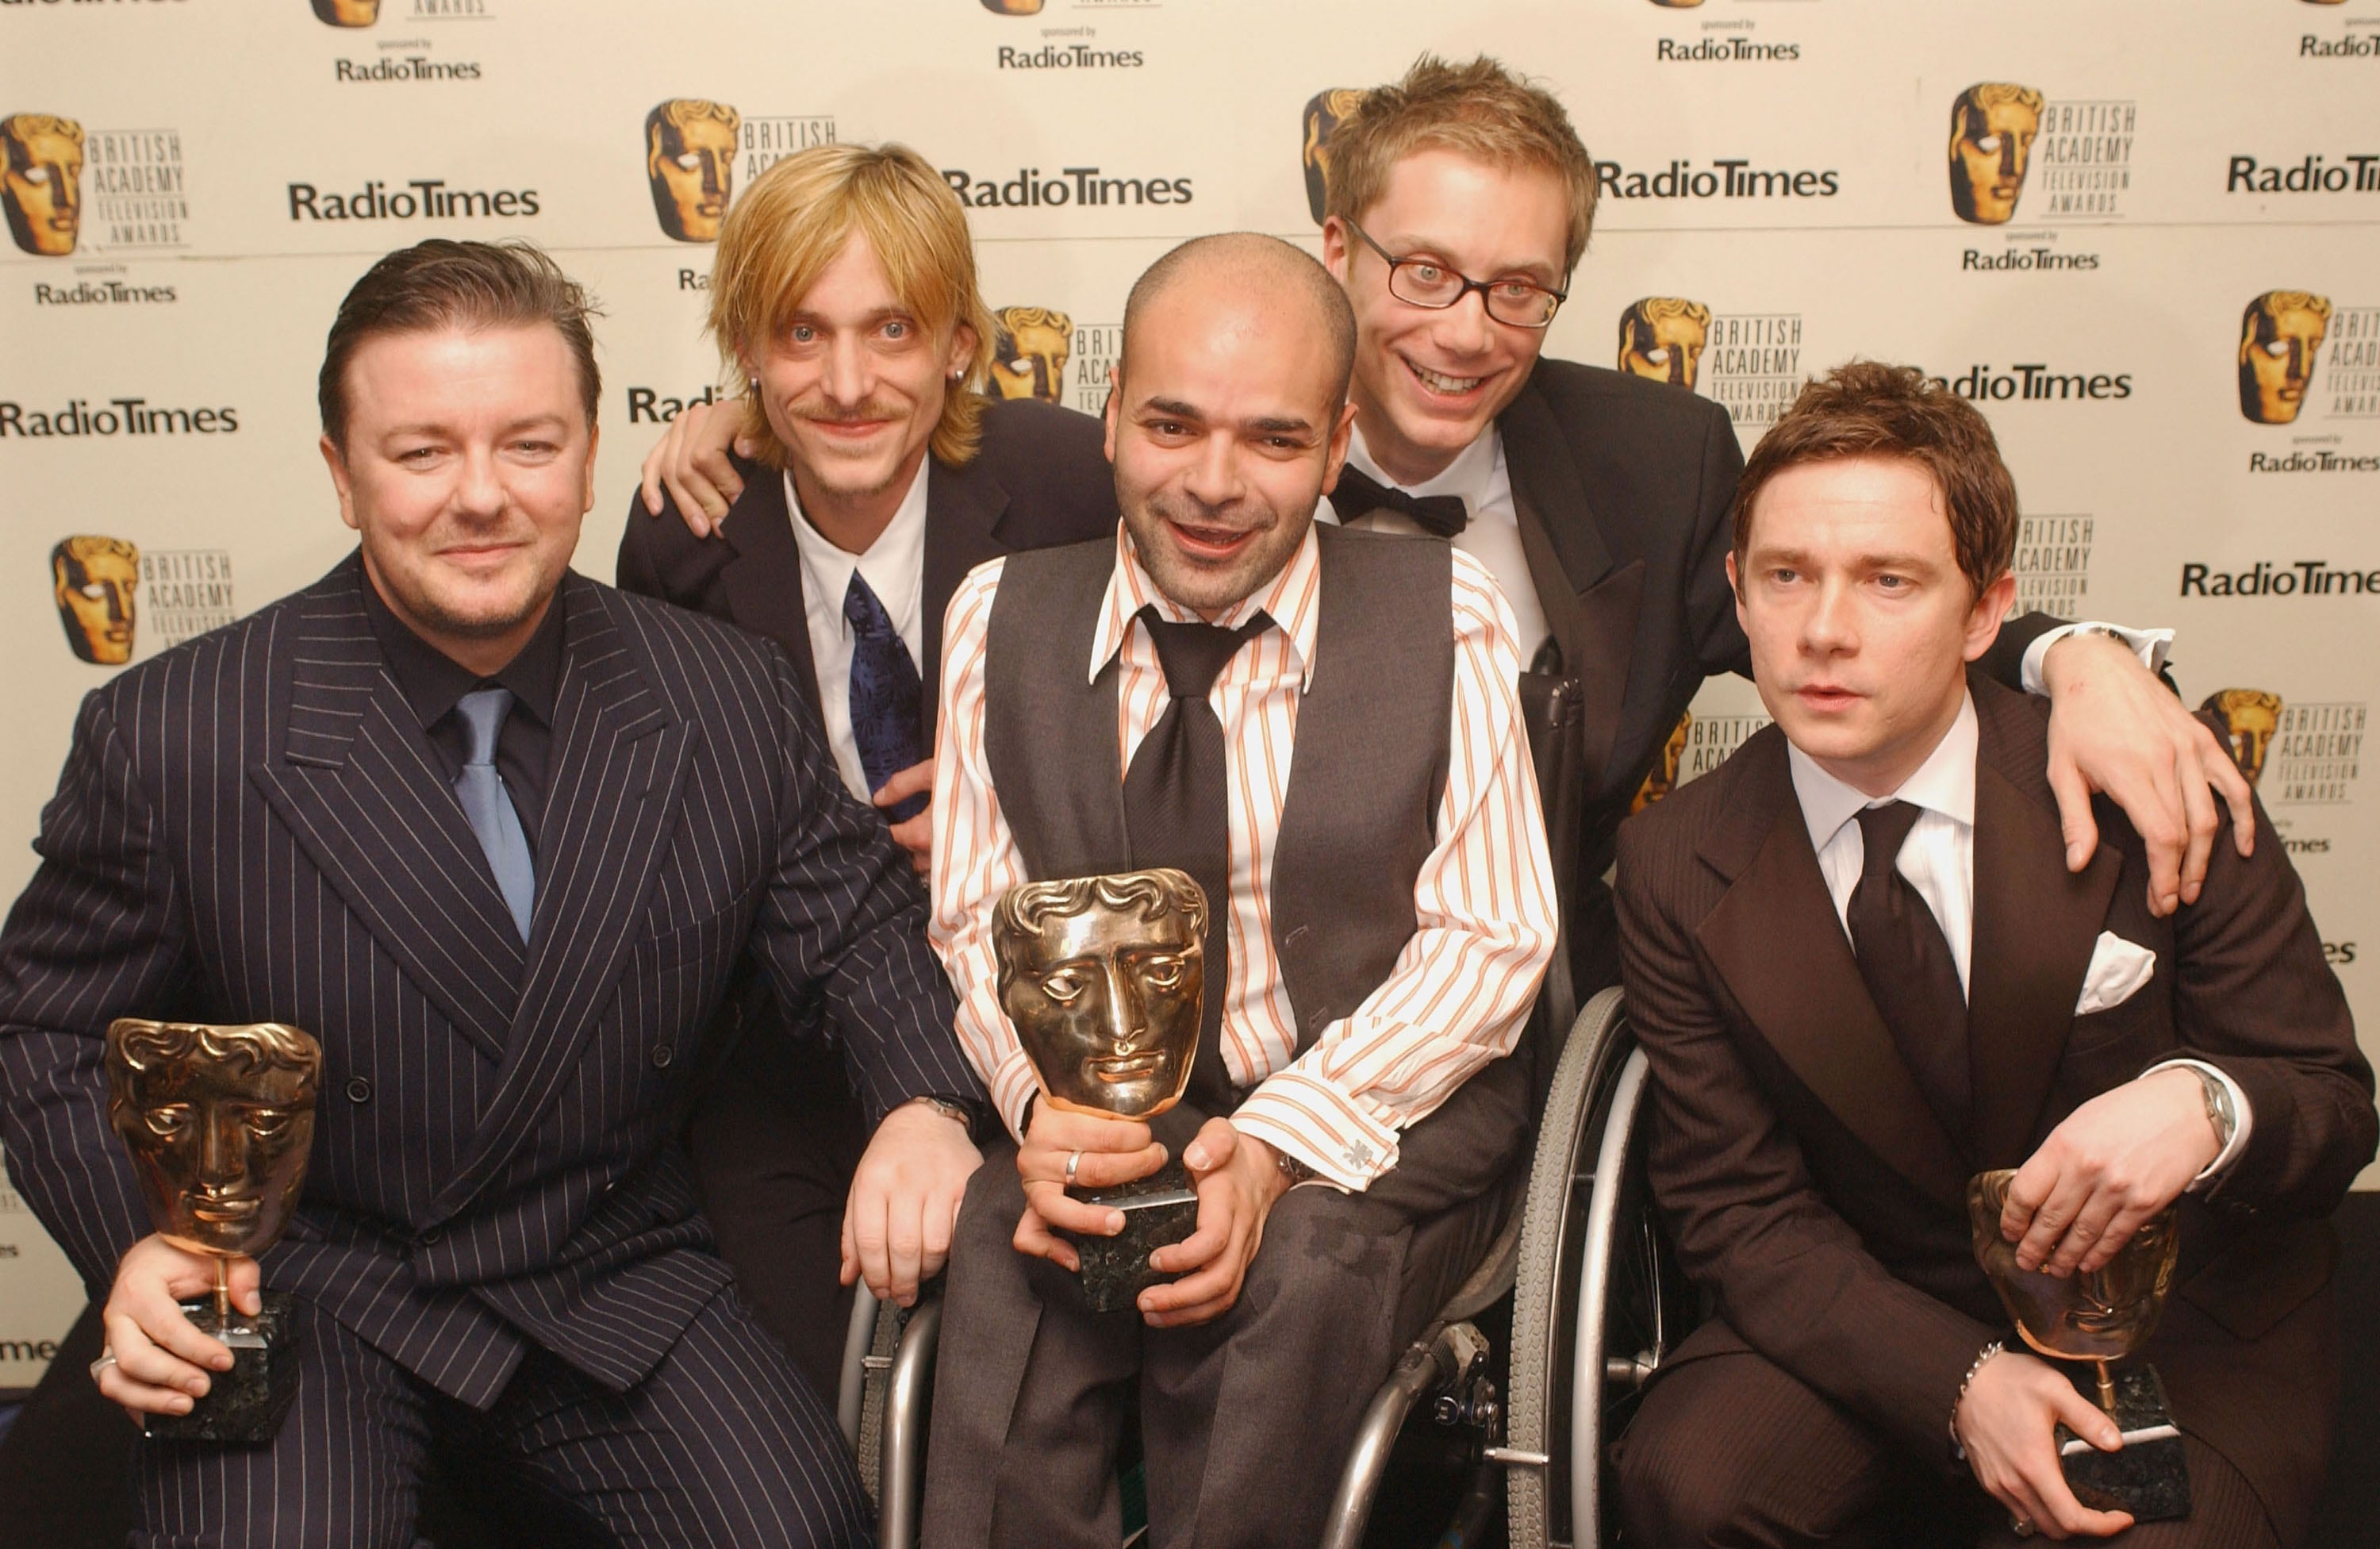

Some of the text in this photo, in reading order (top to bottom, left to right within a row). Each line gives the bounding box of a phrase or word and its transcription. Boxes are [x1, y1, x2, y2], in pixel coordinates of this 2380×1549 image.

[998, 44, 1143, 68] RadioTimes
[1657, 38, 1799, 60] RadioTimes
[336, 56, 481, 81] RadioTimes
[2047, 106, 2136, 133] BRITISH
[744, 121, 836, 149] BRITISH
[88, 135, 182, 163] BRITISH
[2044, 136, 2133, 163] ACADEMY
[94, 167, 183, 193] ACADEMY
[1594, 160, 1839, 198] RadioTimes
[2042, 171, 2129, 190] TELEVISION
[2227, 156, 2380, 192] RadioTi
[942, 168, 1193, 208] RadioTimes
[98, 200, 188, 221] TELEVISION
[288, 180, 539, 221] RadioTimes
[2049, 194, 2116, 212] AWARDS
[110, 224, 180, 244] AWARDS
[1963, 248, 2101, 271] RadioTimes
[35, 282, 177, 305] RadioTimes
[1714, 319, 1802, 346] BRITISH
[1713, 348, 1799, 374] ACADEMY
[2330, 341, 2380, 366] ACAD
[1713, 381, 1798, 401] TELEVISION
[1900, 363, 2132, 400] dioTimes
[0, 398, 238, 437] RadioTimes
[1732, 403, 1777, 421] WARD
[2251, 450, 2380, 472] RadioTimes
[2022, 520, 2093, 544] RITISH
[144, 555, 230, 581] BRITISH
[148, 584, 232, 607] ACADEMY
[2020, 578, 2088, 597] LEVISION
[2284, 709, 2367, 731] BRITISH
[1694, 721, 1773, 745] BRITI
[2280, 735, 2363, 756] ACADEMY
[2278, 764, 2358, 781] TELEVISION
